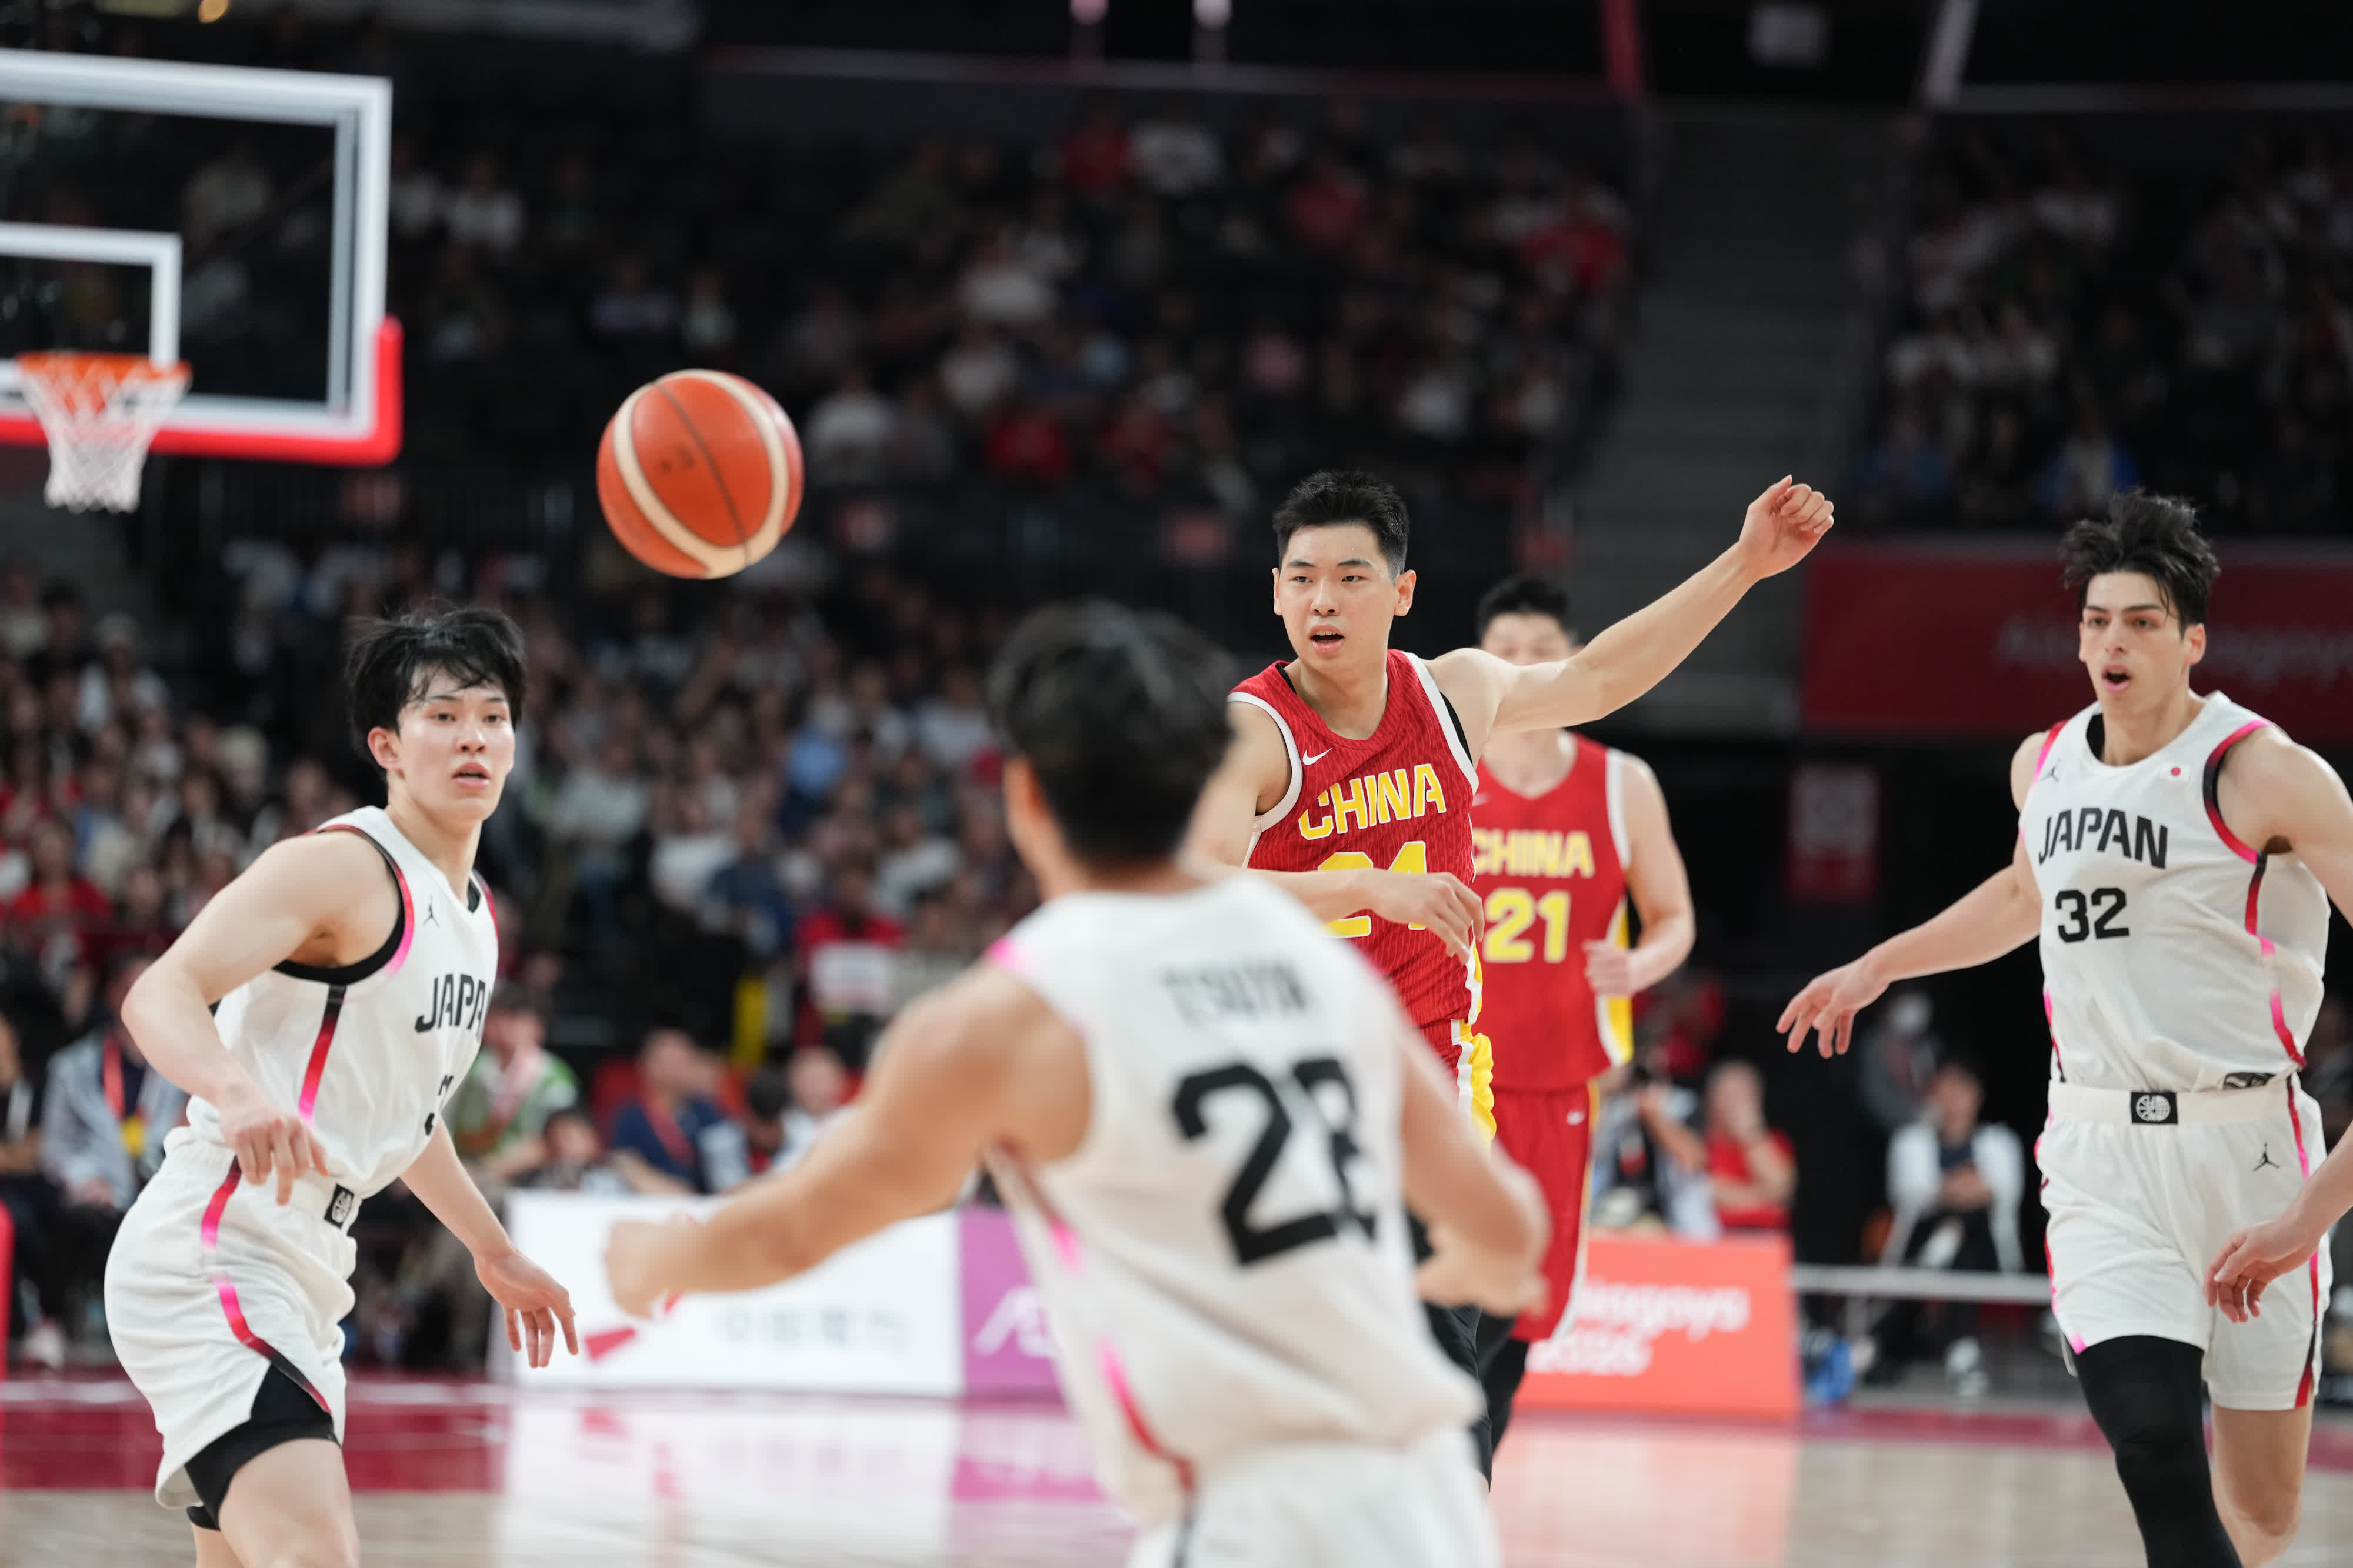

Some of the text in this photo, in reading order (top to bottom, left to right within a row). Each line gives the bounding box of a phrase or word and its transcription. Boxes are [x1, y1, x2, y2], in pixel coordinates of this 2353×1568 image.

[1299, 763, 1447, 840] CHINA
[1472, 829, 1595, 878] CHINA
[2038, 807, 2168, 870] JAPAN
[1483, 888, 1571, 963] 21
[2055, 888, 2130, 943] 32
[414, 973, 492, 1043] JAPA
